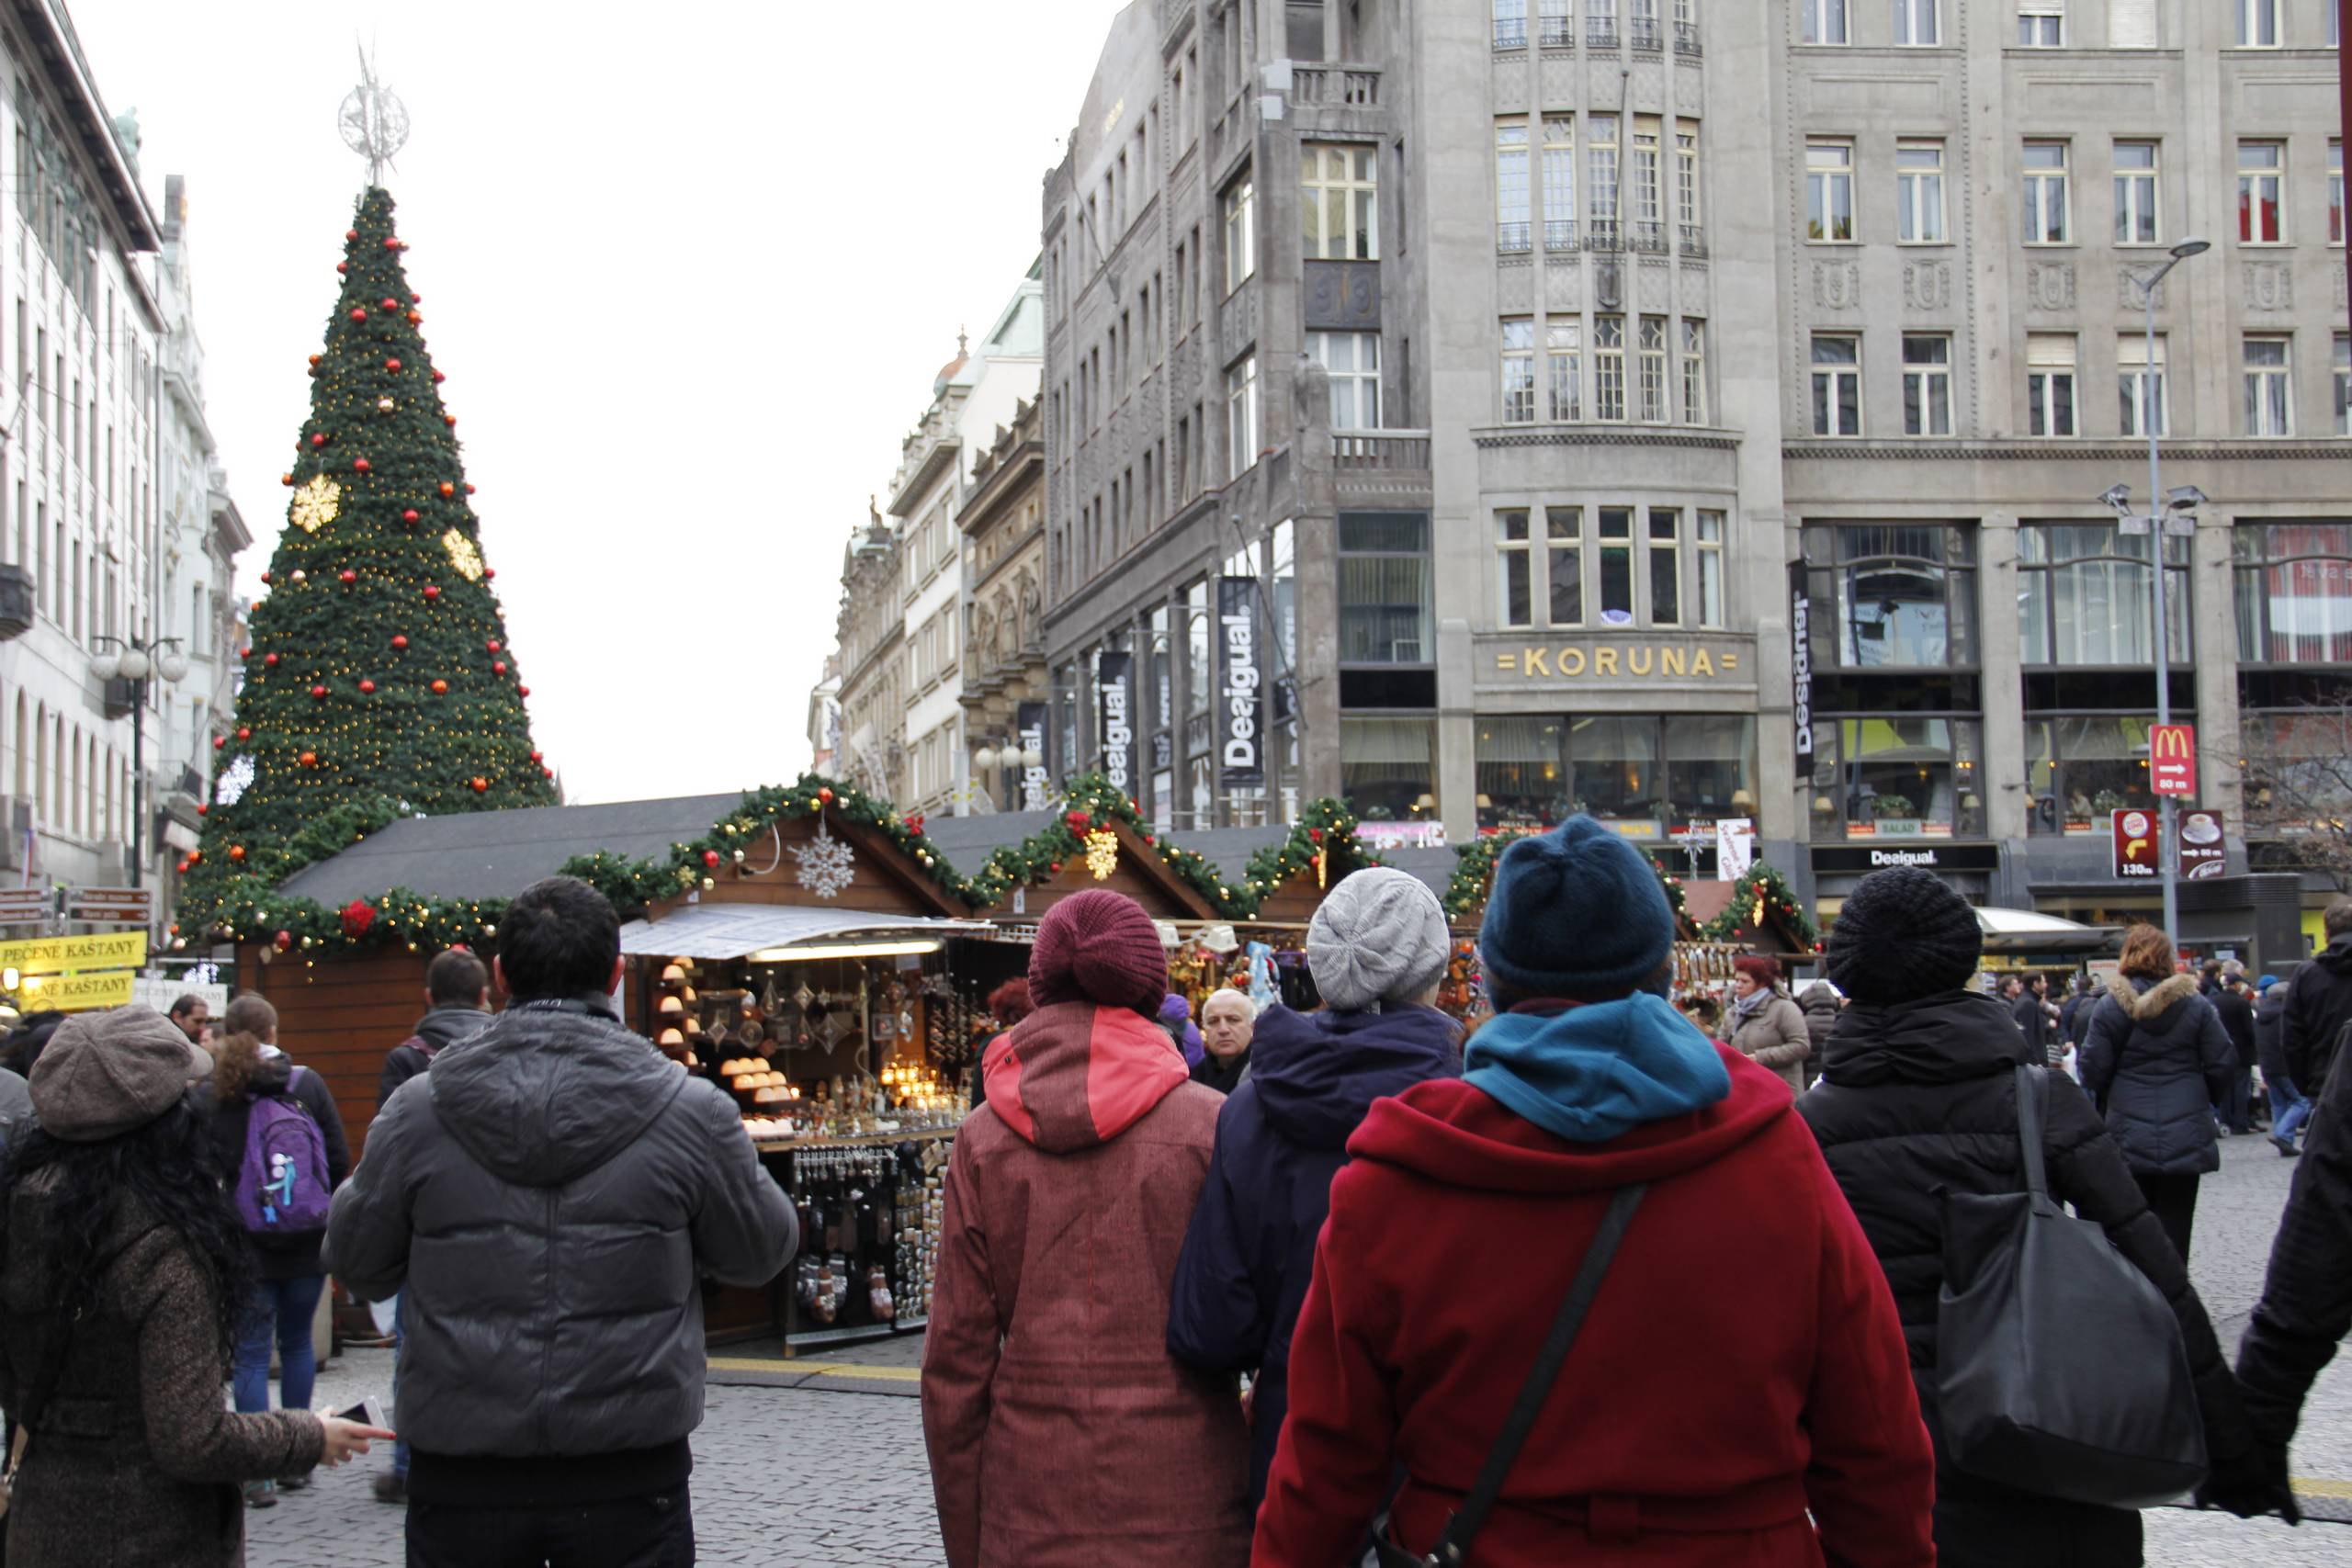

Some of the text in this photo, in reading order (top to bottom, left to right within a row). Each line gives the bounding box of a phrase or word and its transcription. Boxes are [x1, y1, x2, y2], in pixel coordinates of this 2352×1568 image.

[1221, 615, 1260, 767] Desigual
[1102, 683, 1132, 787] esigual
[1871, 849, 1934, 867] Desigual
[3, 938, 136, 961] PEČENÉ KAŠTANY
[63, 977, 130, 995] KAŠTANY
